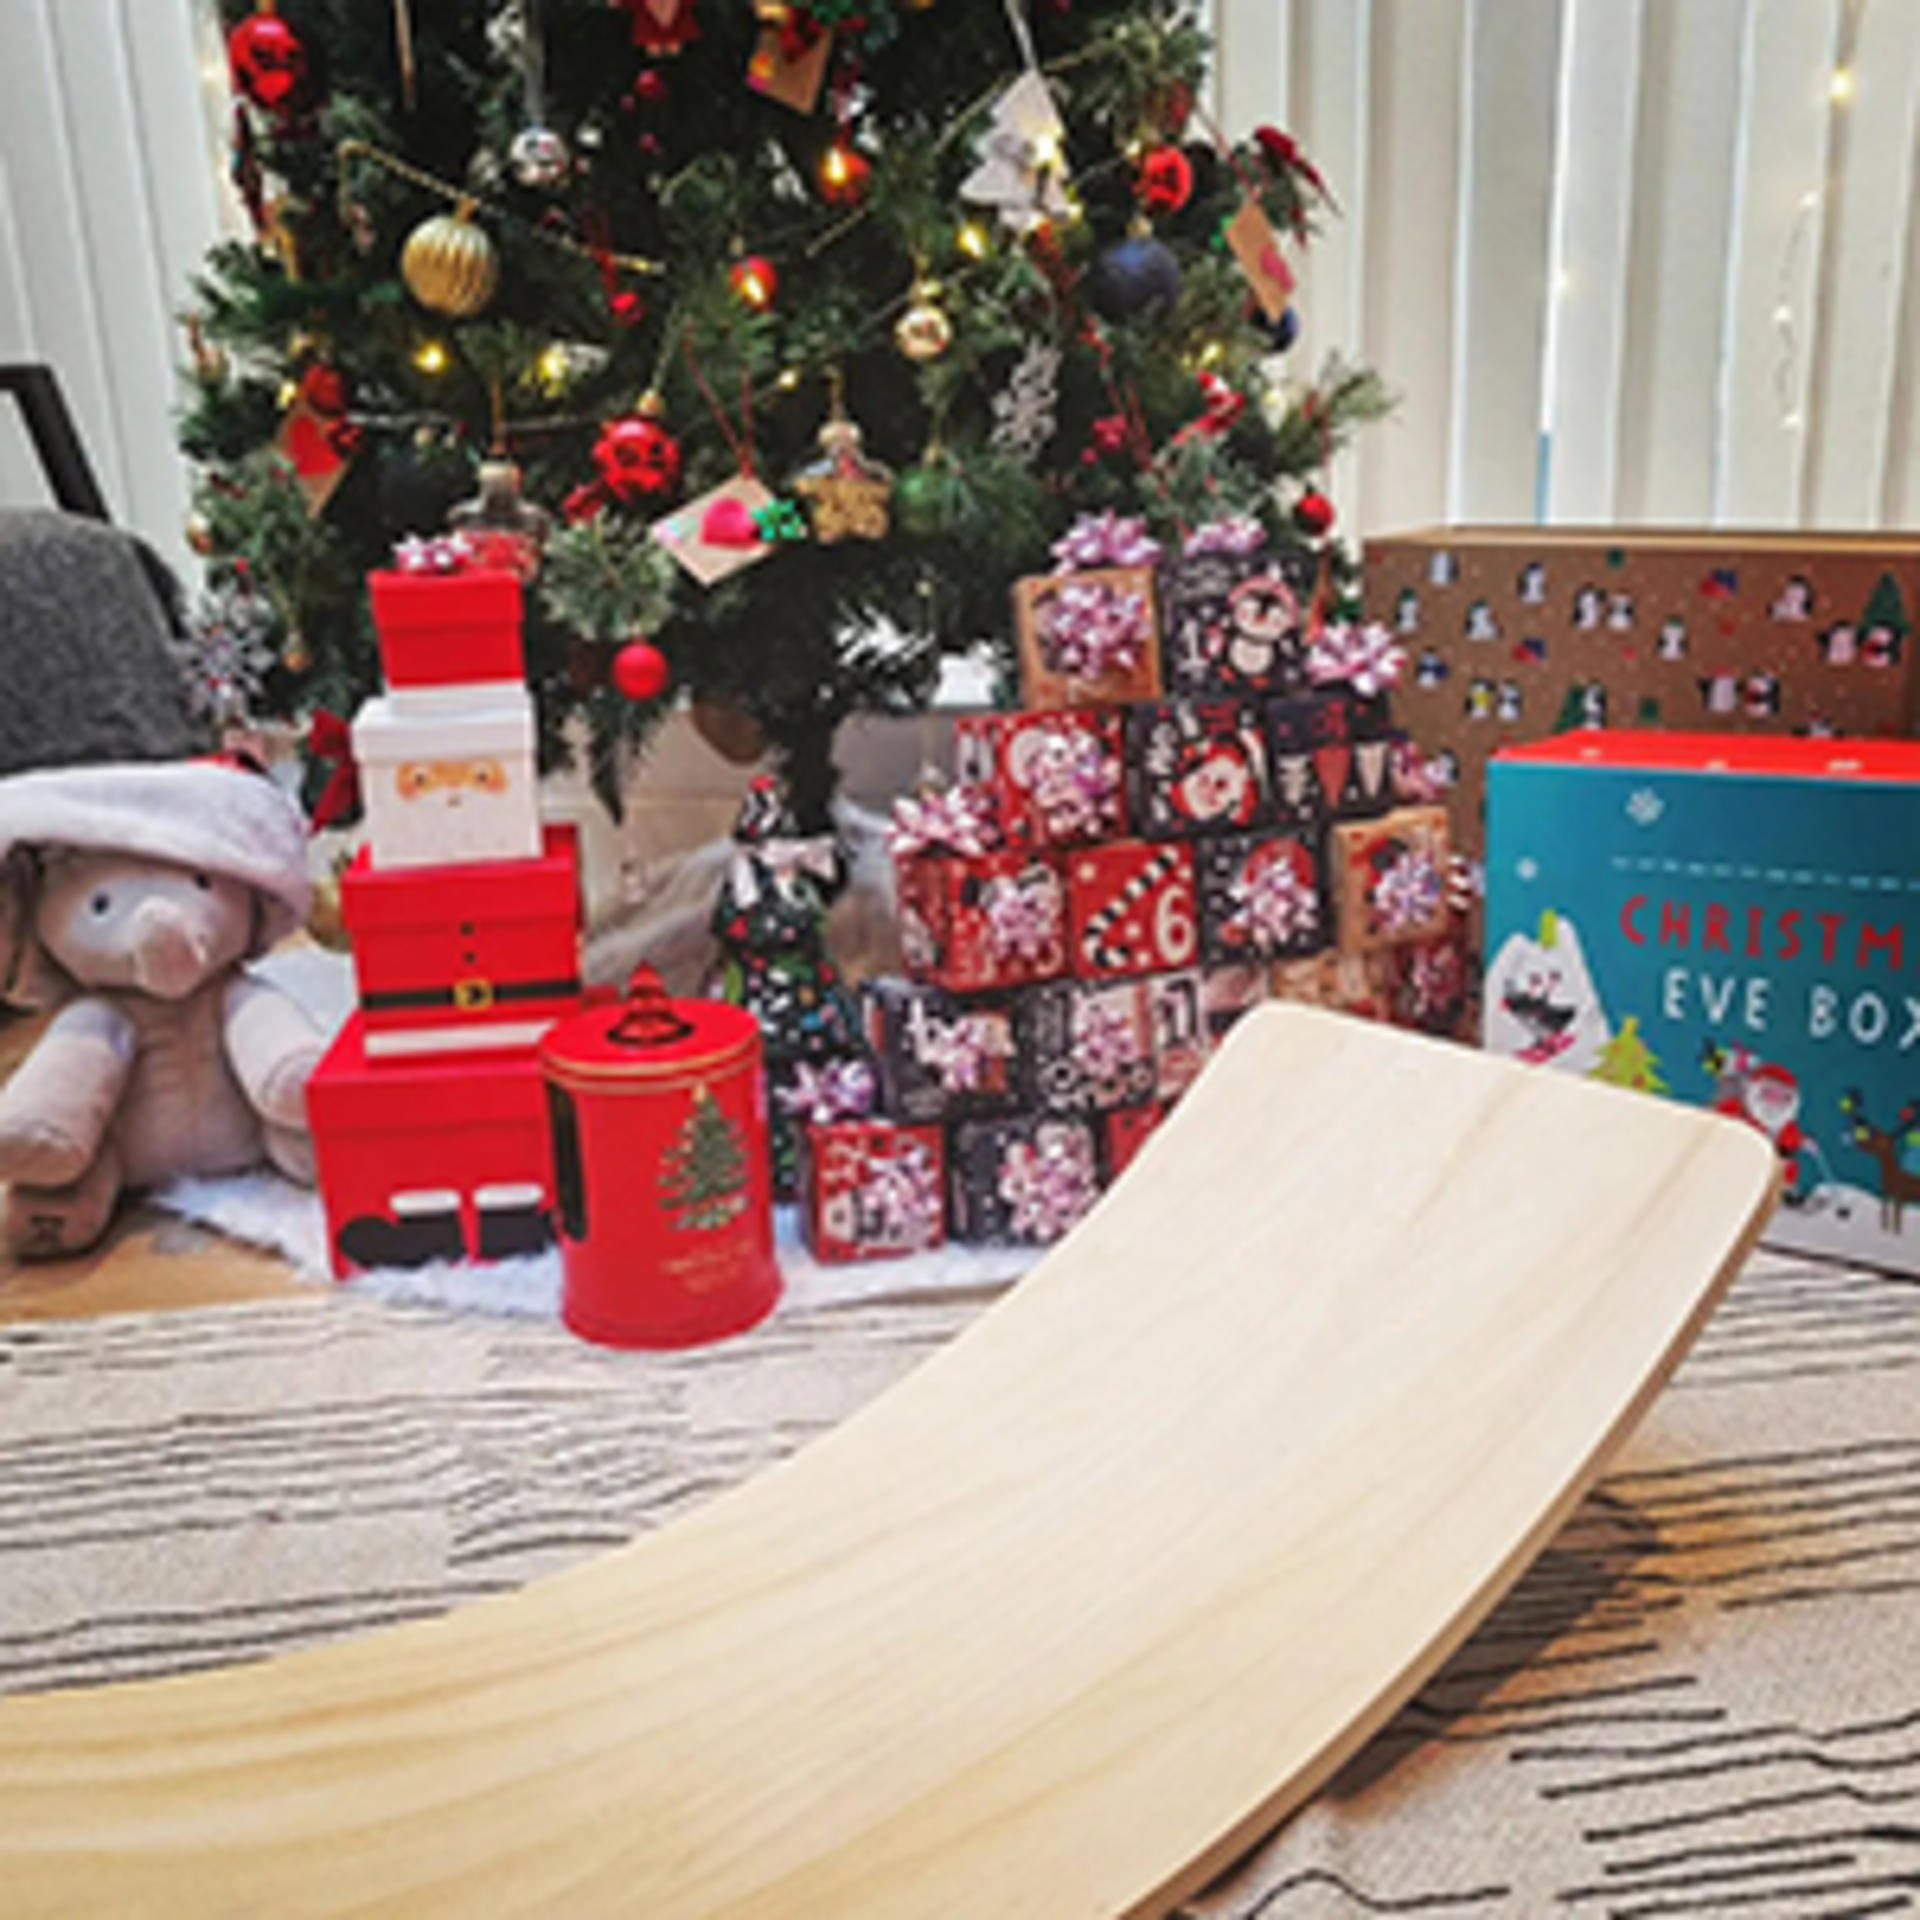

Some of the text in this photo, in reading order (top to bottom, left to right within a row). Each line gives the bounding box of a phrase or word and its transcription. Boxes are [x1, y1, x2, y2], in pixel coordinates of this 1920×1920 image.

[1155, 886, 1194, 963] 6
[1619, 894, 1920, 970] CHRISTM
[1663, 966, 1770, 1031] EVE
